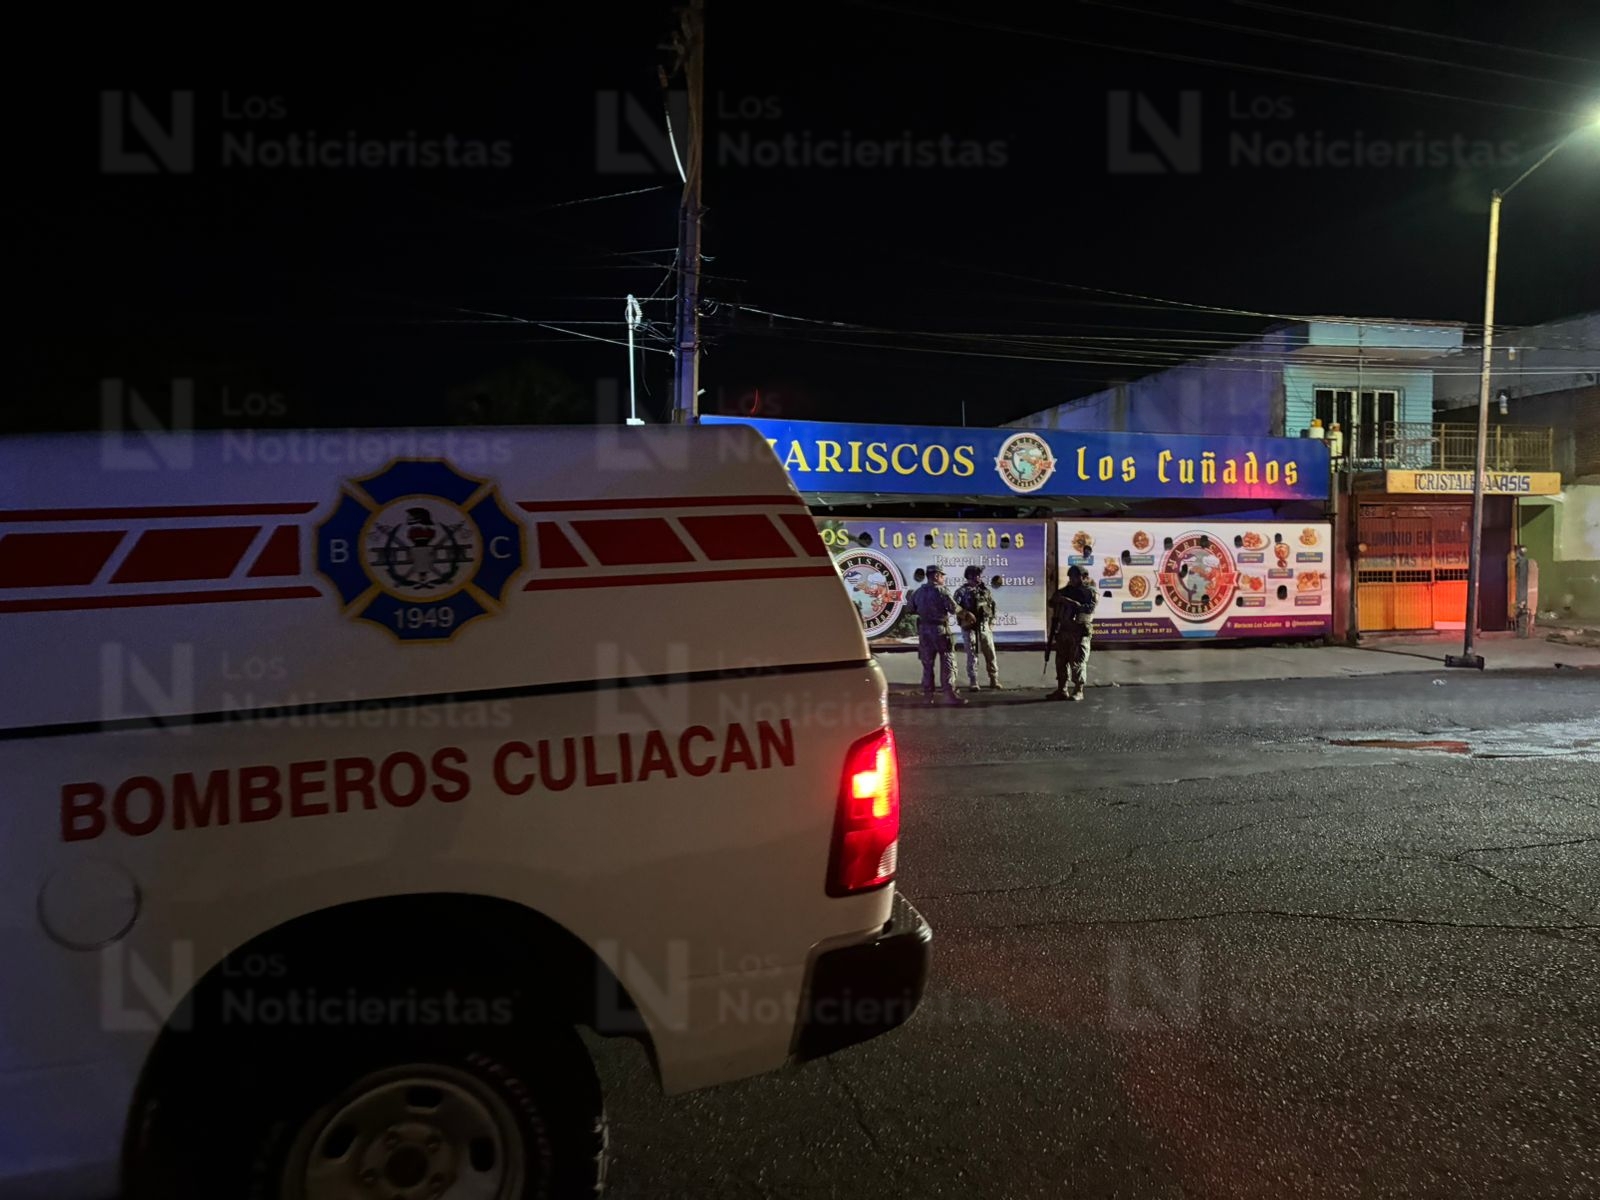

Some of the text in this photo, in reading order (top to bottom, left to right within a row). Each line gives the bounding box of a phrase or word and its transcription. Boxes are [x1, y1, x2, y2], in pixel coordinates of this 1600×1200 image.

[767, 438, 975, 477] ARISCOS
[329, 537, 350, 564] B
[489, 536, 512, 559] C
[393, 605, 455, 629] 1949
[61, 718, 796, 842] BOMBEROS CULIACAN
